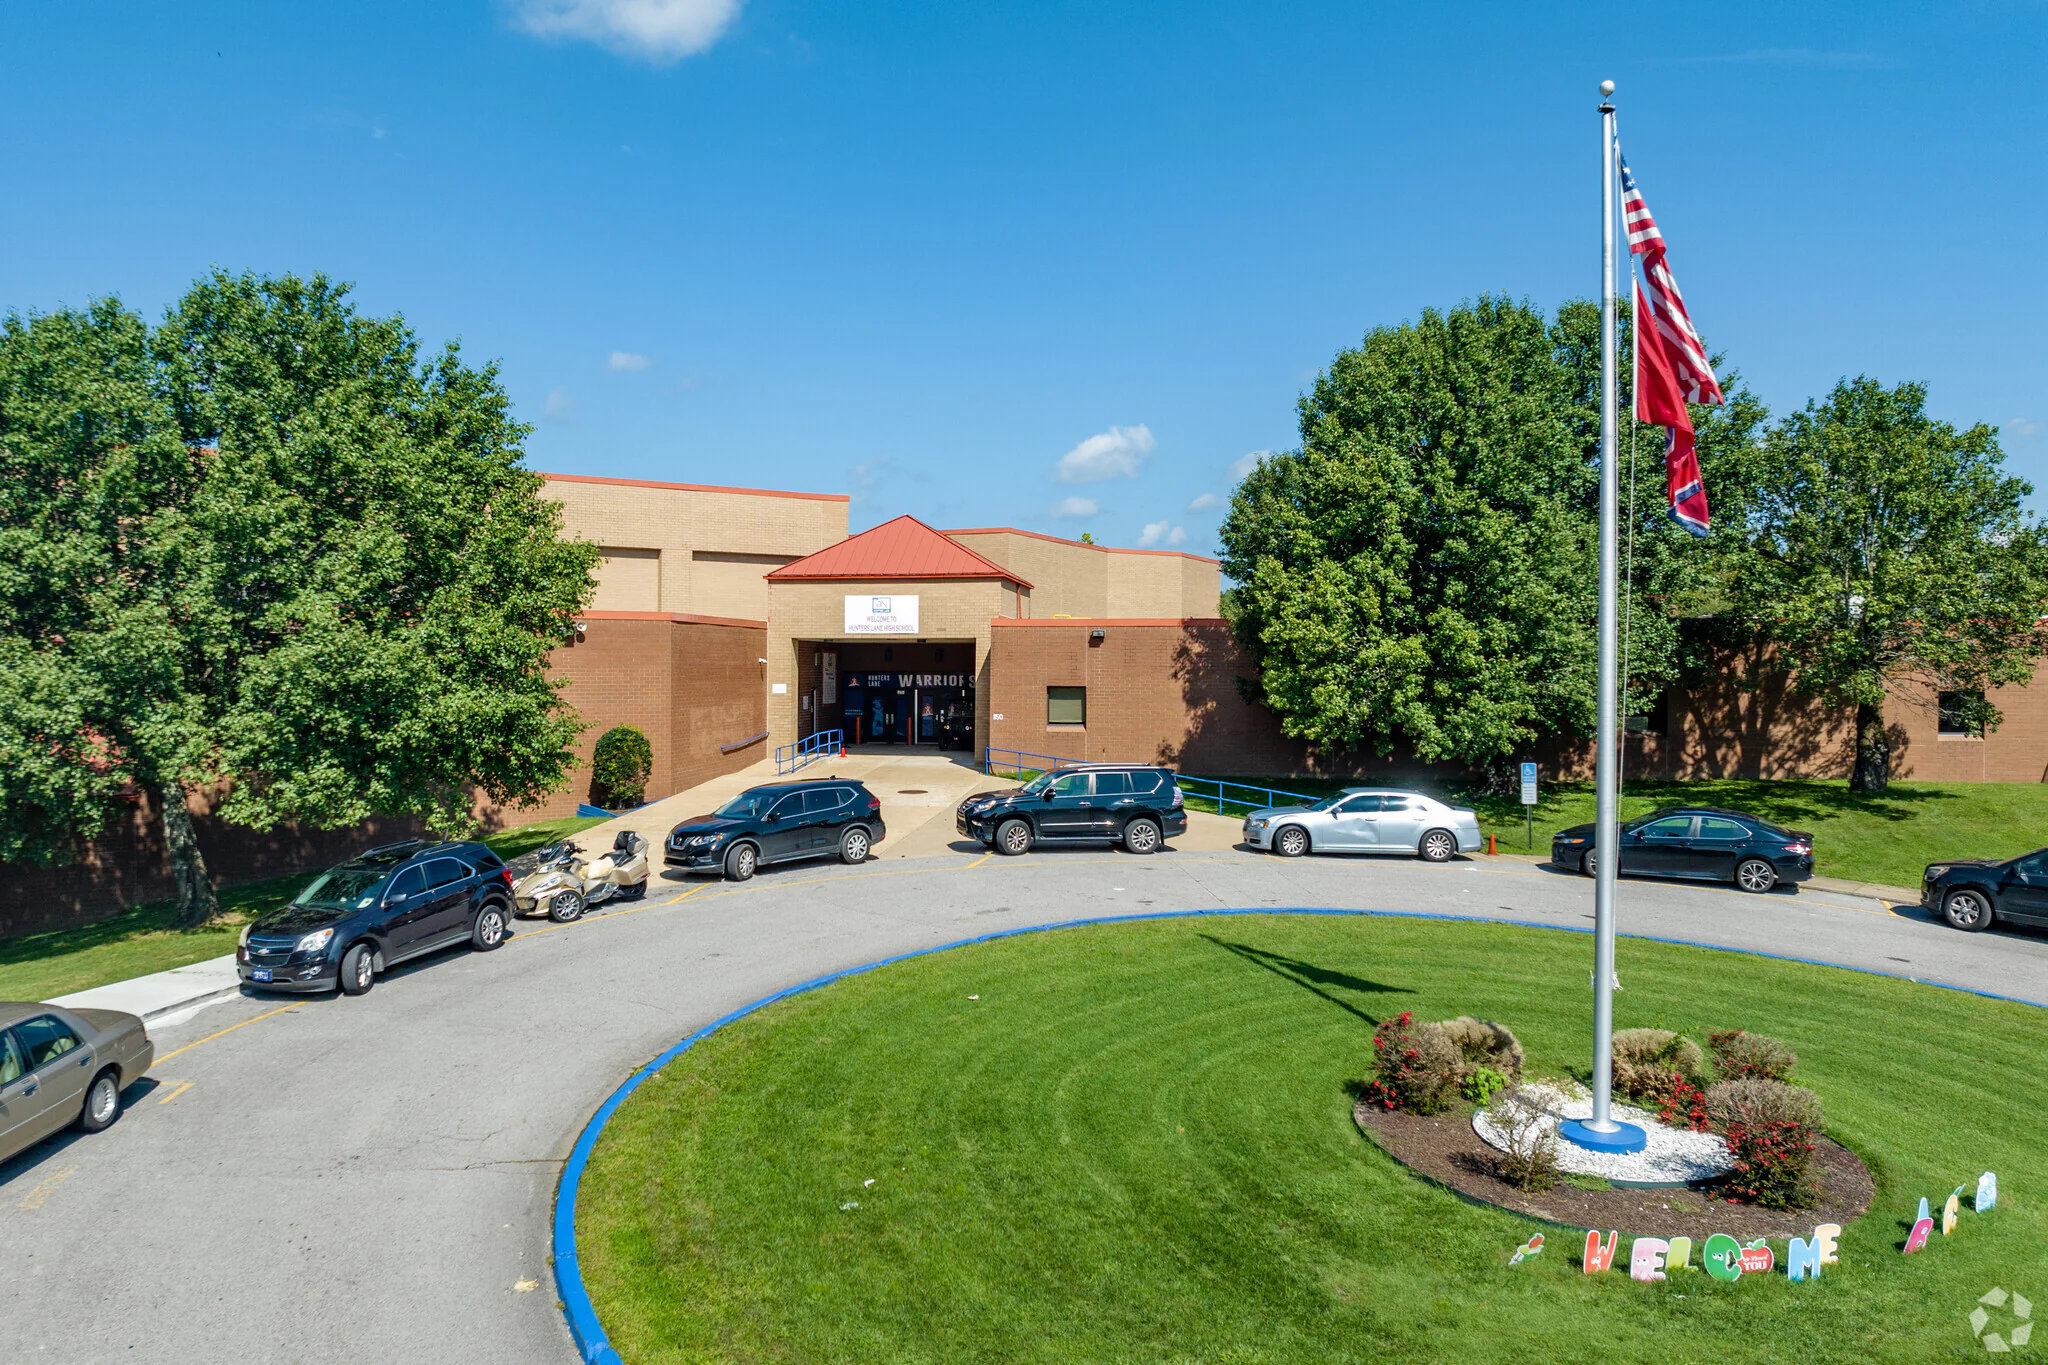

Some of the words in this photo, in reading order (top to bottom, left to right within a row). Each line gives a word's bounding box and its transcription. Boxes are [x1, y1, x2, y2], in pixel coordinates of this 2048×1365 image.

[866, 615, 890, 623] WELCOME
[848, 624, 870, 632] HUNTERS
[871, 624, 883, 632] LANE
[884, 624, 895, 632] HIGH
[896, 624, 915, 632] SCHOOL
[1743, 1260, 1768, 1271] YOU
